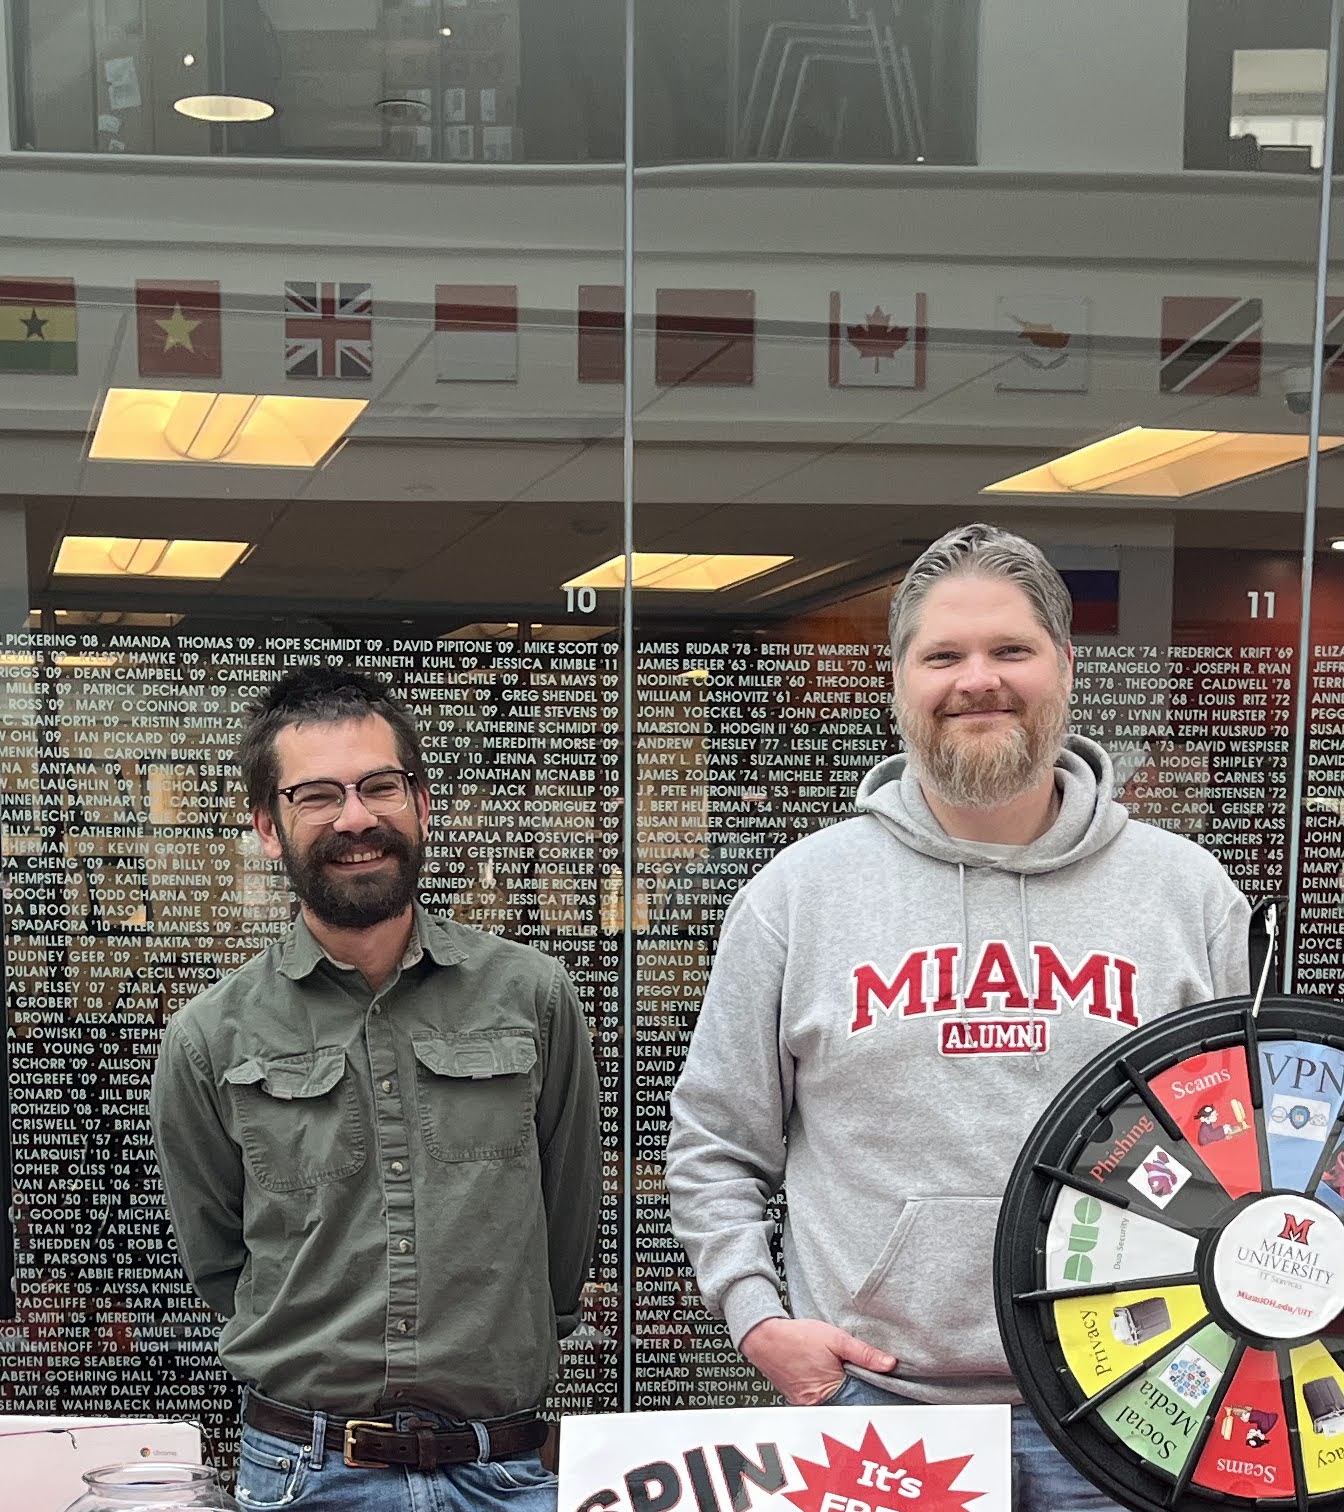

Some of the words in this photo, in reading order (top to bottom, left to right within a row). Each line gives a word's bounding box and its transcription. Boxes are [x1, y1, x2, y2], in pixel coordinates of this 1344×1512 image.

[564, 588, 596, 612] 10
[1248, 592, 1274, 618] 11
[5, 633, 76, 646] PICKERING
[79, 634, 98, 647] '08
[108, 635, 171, 648] AMANDA
[176, 636, 234, 648] THOMAS
[235, 637, 255, 649] '09
[265, 637, 300, 650] HOPE
[303, 638, 361, 650] SCHMIDT
[363, 639, 382, 651] '09
[392, 639, 433, 651] DAVID
[436, 640, 492, 652] PIPITONE
[495, 641, 514, 653] '09
[523, 641, 555, 653] MIKE
[557, 642, 598, 654] SCOTT
[600, 642, 620, 654] '09
[636, 642, 679, 654] JAMES
[685, 642, 729, 654] RUDAR
[731, 643, 750, 655] '78
[760, 643, 790, 655] BETH
[792, 643, 814, 655] UTZ
[816, 644, 869, 656] WARREN
[1166, 646, 1233, 658] FREDERICK
[1239, 646, 1272, 658] KRIFT
[1274, 647, 1293, 658] '69
[847, 940, 1142, 1040] MIAMI
[946, 1024, 1043, 1049] ALUMNI
[1172, 1066, 1231, 1100] Scams
[1090, 1114, 1154, 1184] Phishing
[1116, 1218, 1130, 1254] Security
[1237, 1246, 1334, 1284] UNIVERSITY
[1260, 1238, 1320, 1266] MIAMI
[1080, 1309, 1112, 1376] Privacy
[61, 1399, 150, 1410] WAHNBAECK
[155, 1398, 232, 1409] HAMMOND
[1138, 1380, 1200, 1438] Media
[1118, 1406, 1178, 1460] Social
[856, 1458, 924, 1500] It's
[1216, 1458, 1277, 1484] Scams
